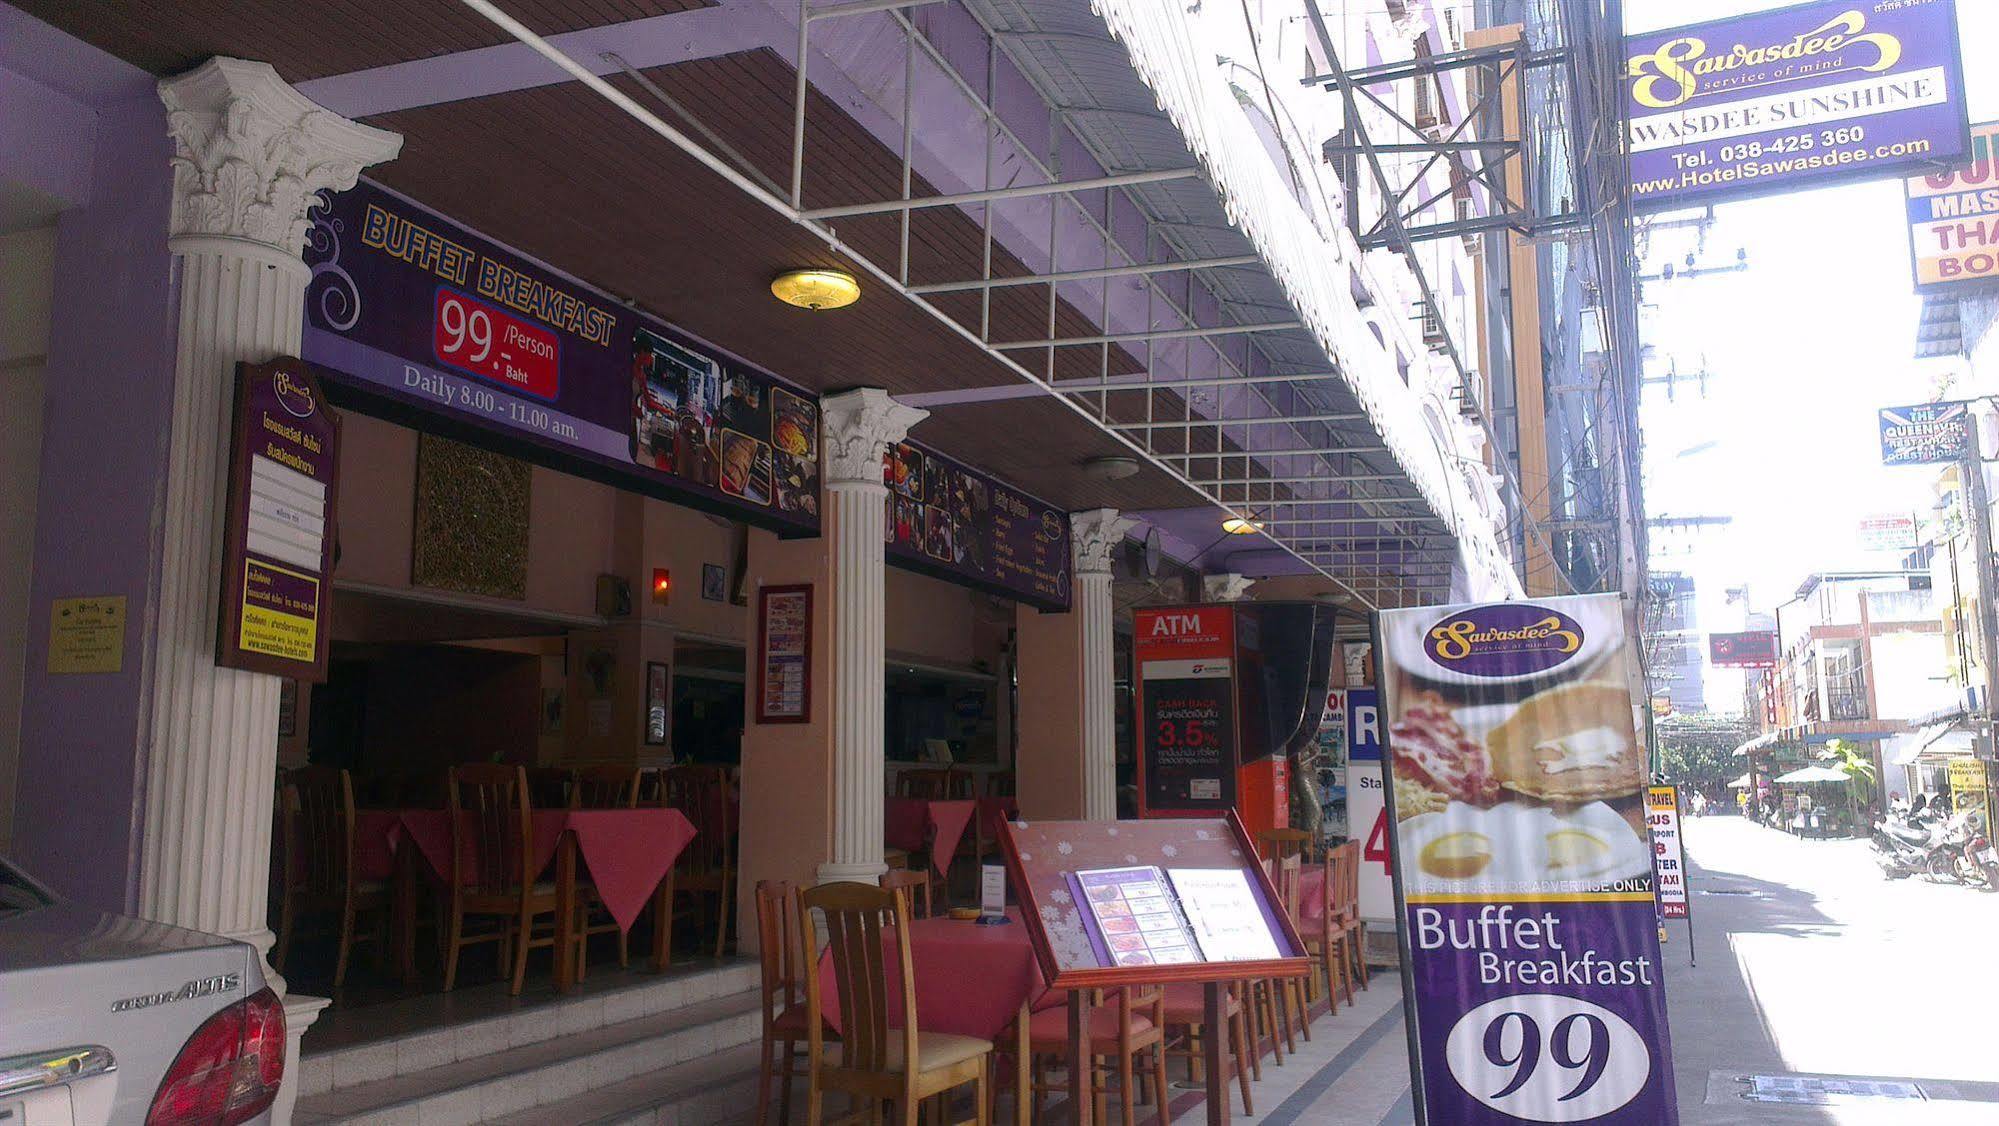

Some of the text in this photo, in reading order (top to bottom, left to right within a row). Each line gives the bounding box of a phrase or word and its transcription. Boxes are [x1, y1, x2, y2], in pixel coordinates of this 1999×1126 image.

[1627, 10, 1901, 108] Sawasdee
[1704, 57, 1843, 89] service of mind
[1770, 77, 1932, 122] SUNSHINE
[1672, 125, 1864, 170] Tel. 038-425 360
[362, 203, 616, 347] BUFFET BREAKFAST
[1938, 252, 1999, 277] BO
[506, 364, 529, 385] Baht
[404, 364, 456, 406] Daily
[460, 385, 495, 412] 8.00
[509, 402, 549, 431] 11.00
[552, 418, 580, 441] am.
[1909, 410, 1935, 423] THE
[1152, 614, 1201, 636] ATM
[1431, 616, 1578, 660] Sawasdee
[1651, 814, 1670, 826] US
[1613, 879, 1651, 892] ONLY
[1416, 904, 1562, 950] Buffet
[1478, 950, 1652, 985] Breakfast
[1483, 1011, 1610, 1102] 99
